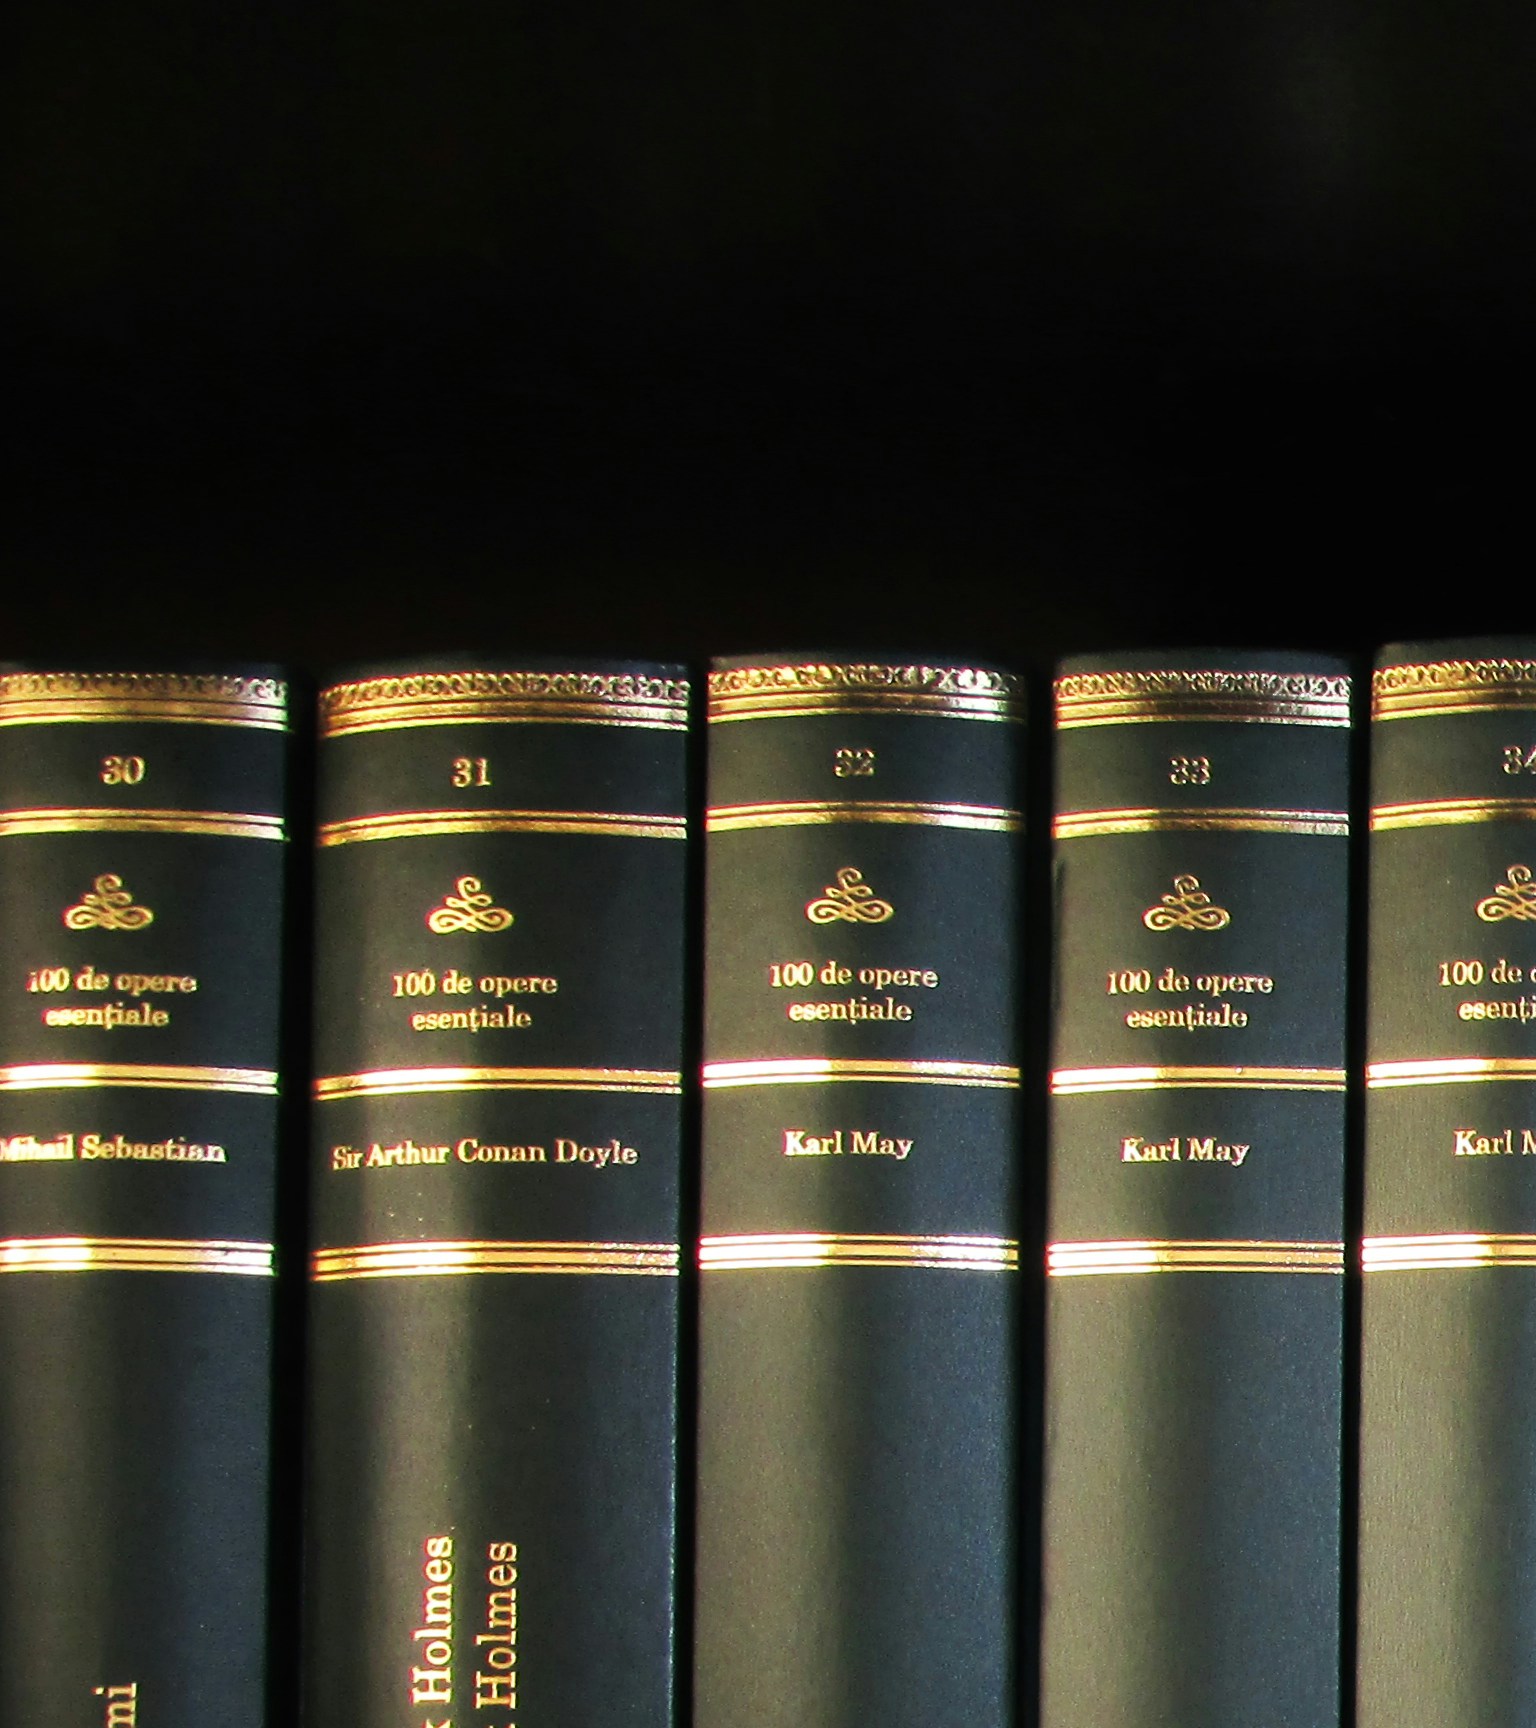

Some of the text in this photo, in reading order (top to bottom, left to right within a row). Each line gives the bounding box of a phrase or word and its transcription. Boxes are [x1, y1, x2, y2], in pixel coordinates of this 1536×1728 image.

[100, 756, 144, 785] 30
[452, 757, 491, 787] 31
[26, 965, 197, 997] 100 de opere
[393, 969, 558, 998] 100 de opere
[770, 960, 938, 990] 100 de opere
[1108, 967, 1273, 997] 100 de opere
[1439, 960, 1483, 986] 100
[1490, 958, 1522, 983] de
[79, 1134, 226, 1163] Sebastian
[332, 1138, 637, 1170] Sir Arthur Conan Doyle
[783, 1130, 913, 1160] Karl May
[1122, 1137, 1249, 1166] Karl May
[1454, 1129, 1513, 1155] Karl
[410, 1537, 452, 1705] Holmes
[474, 1542, 517, 1709] Holmes
